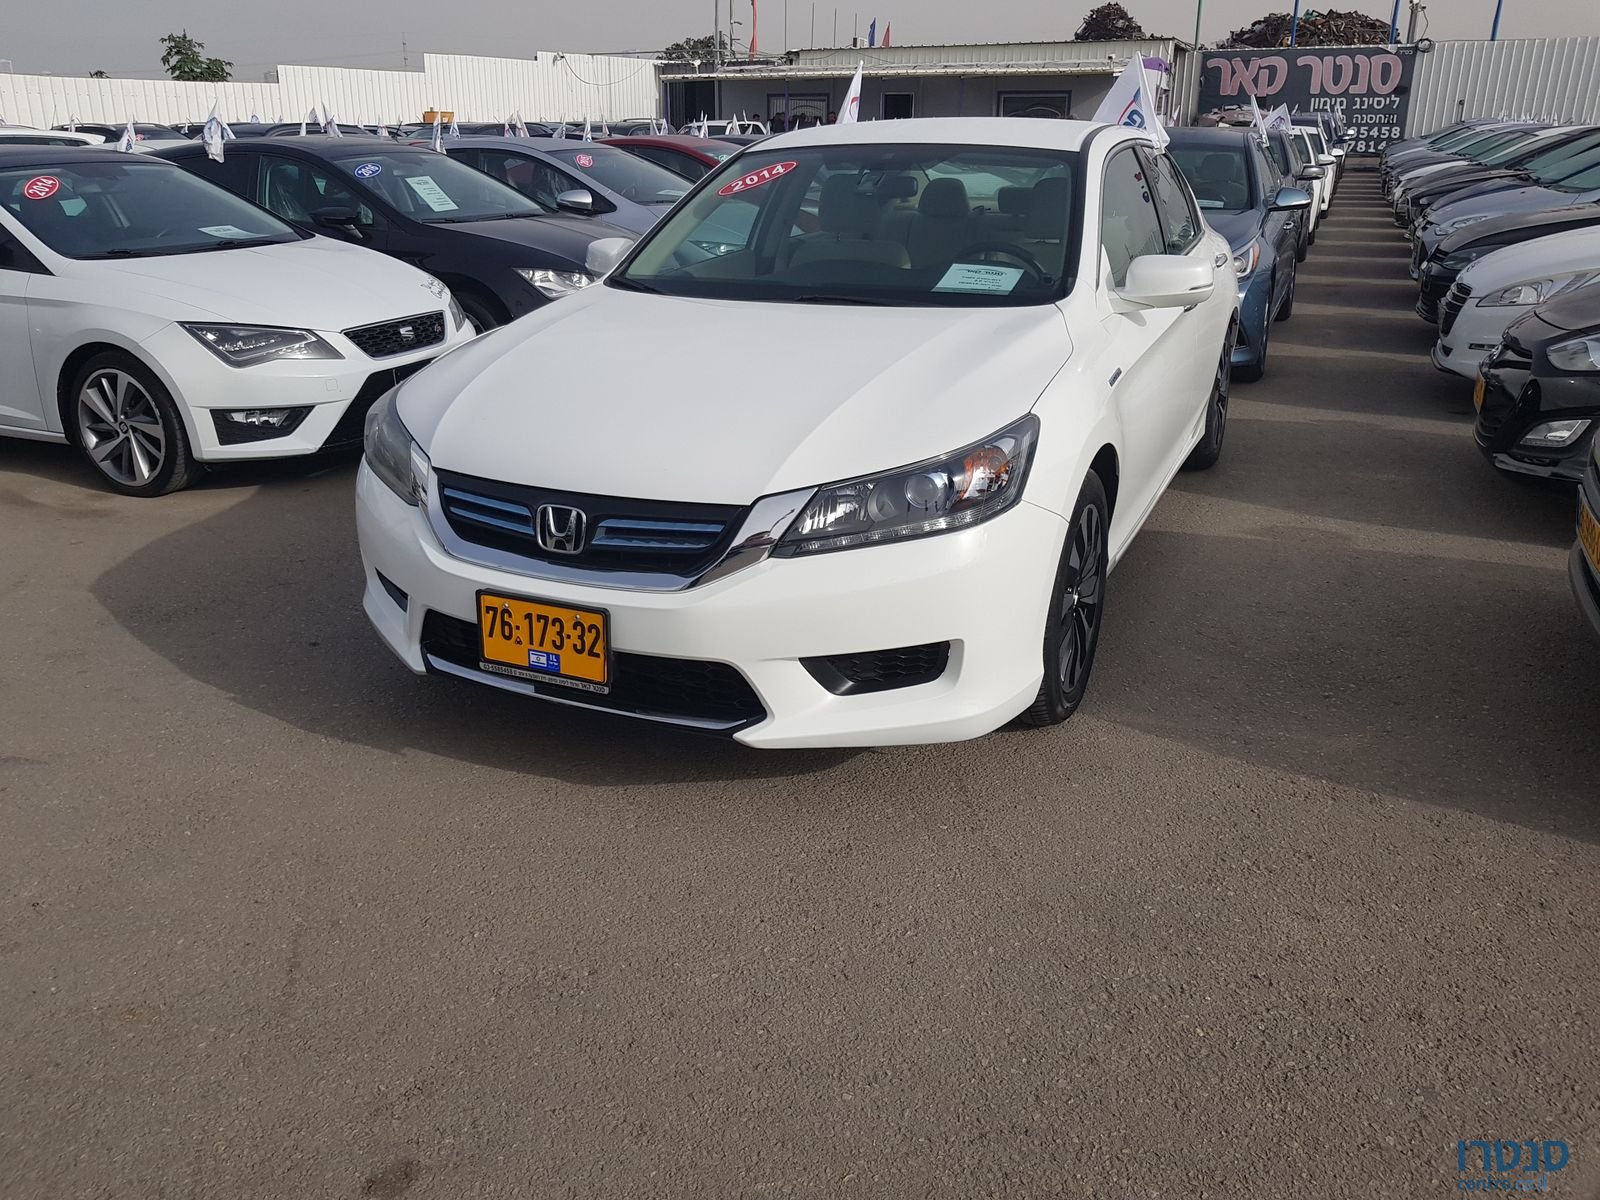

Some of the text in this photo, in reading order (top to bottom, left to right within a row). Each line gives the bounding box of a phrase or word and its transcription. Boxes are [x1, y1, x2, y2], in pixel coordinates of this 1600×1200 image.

[1206, 54, 1403, 97] סנטר קאר
[1309, 94, 1401, 113] ליסינג מימון
[28, 178, 56, 197] 2014
[731, 164, 786, 192] 2014
